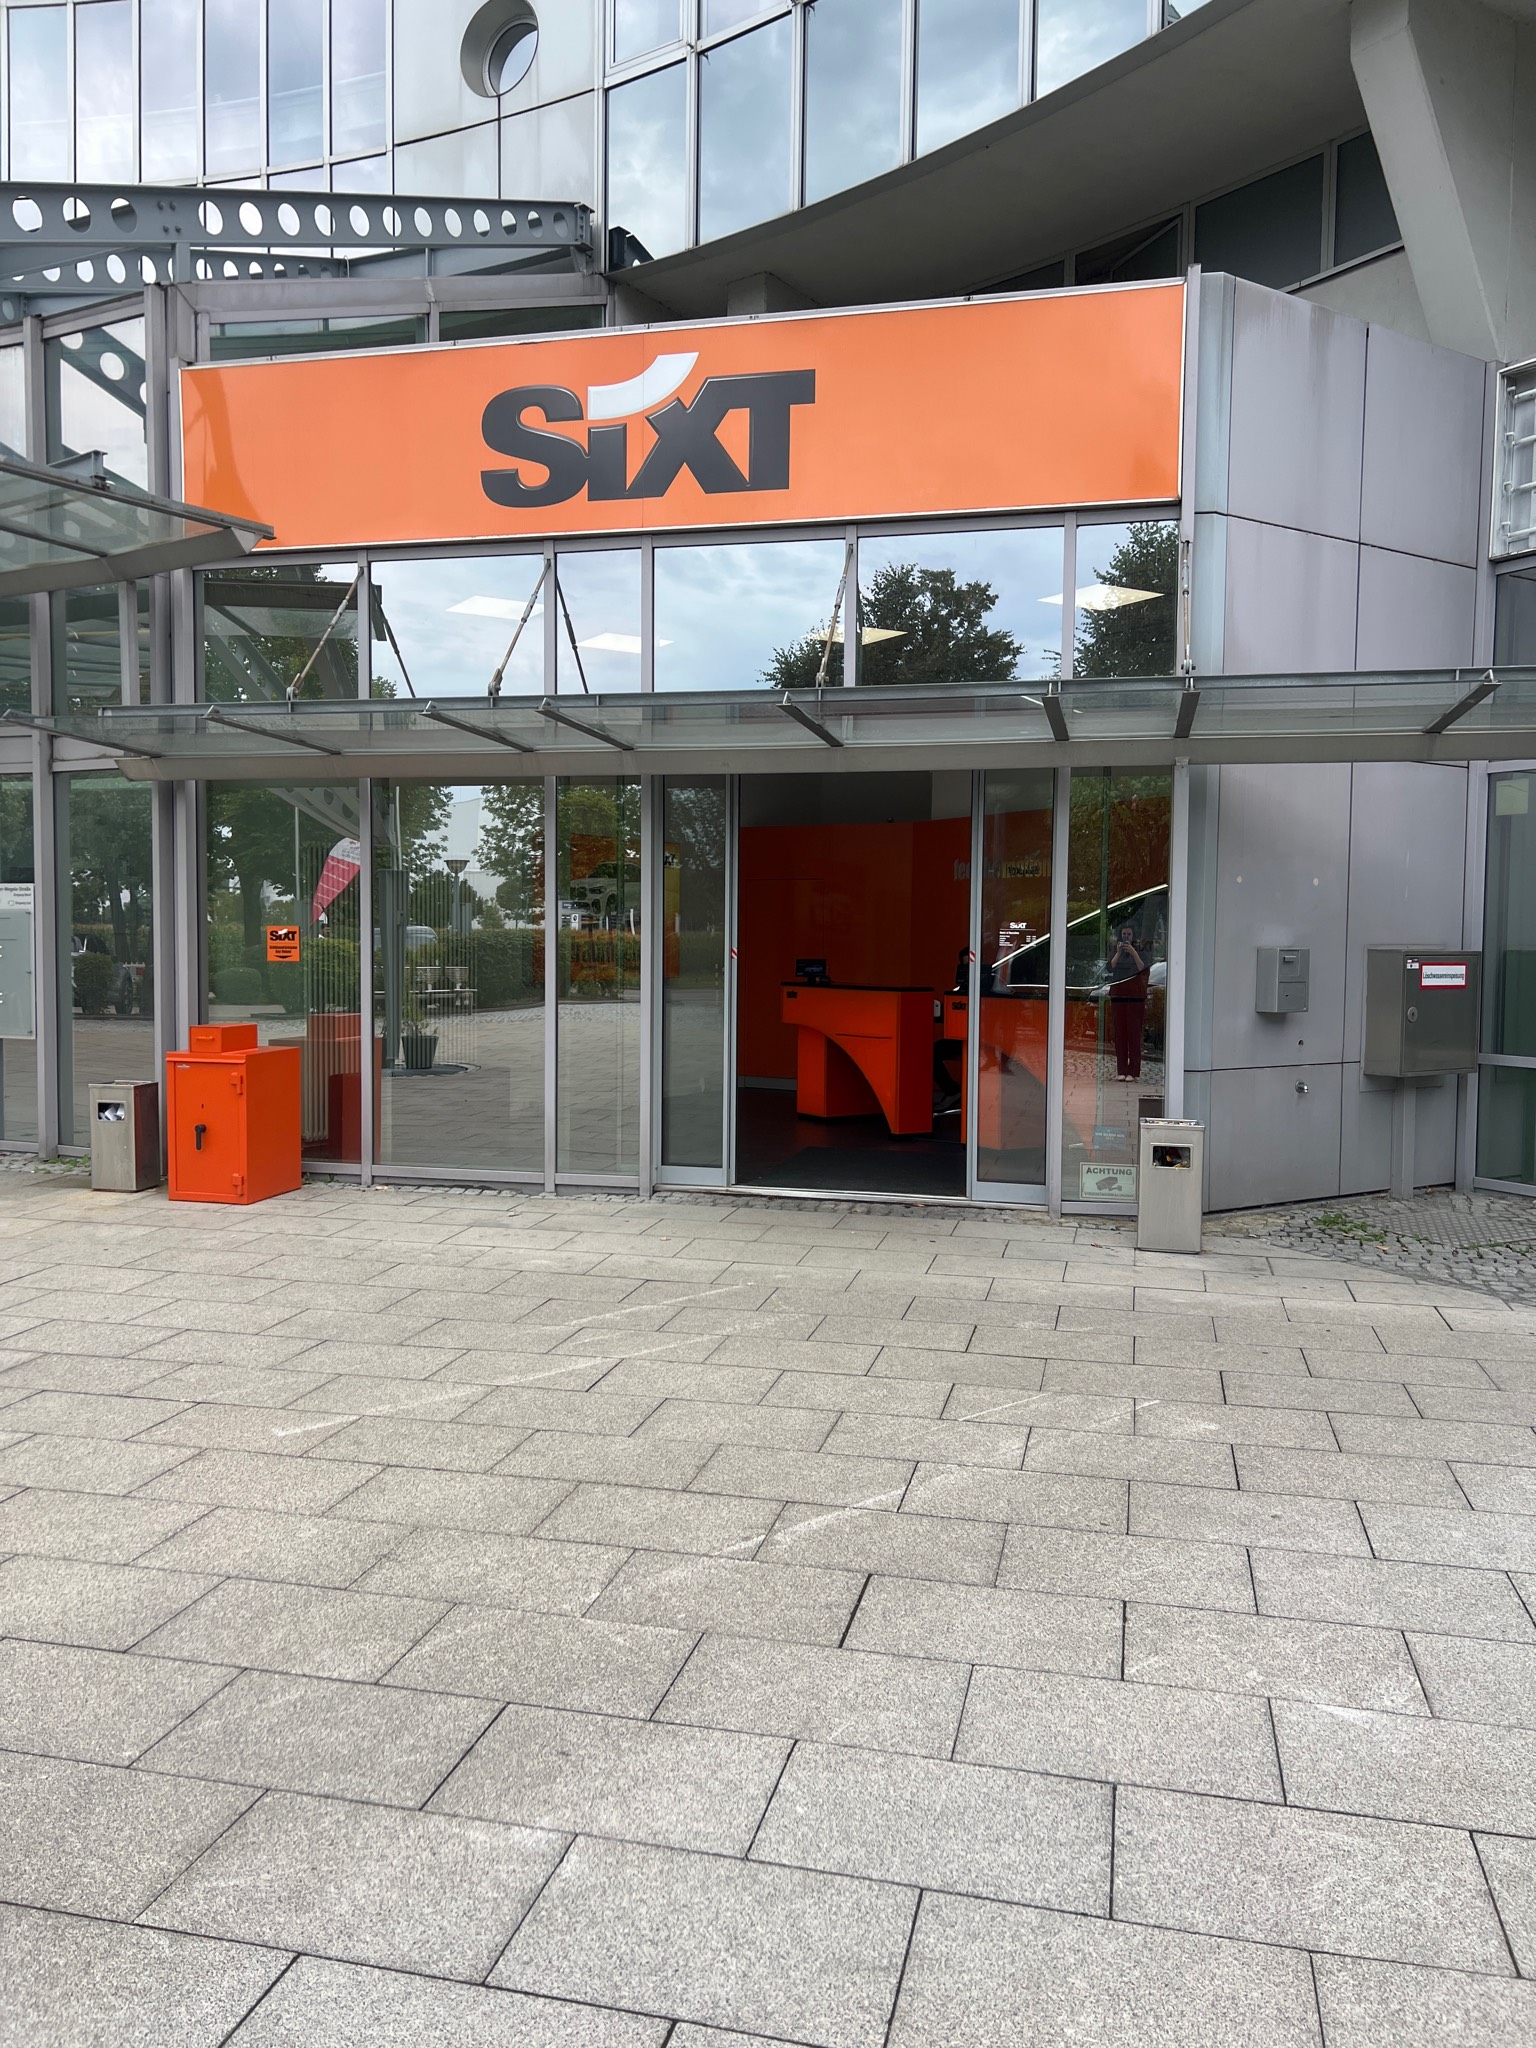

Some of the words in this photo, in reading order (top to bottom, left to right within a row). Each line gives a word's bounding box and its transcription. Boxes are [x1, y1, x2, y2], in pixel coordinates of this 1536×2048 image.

[481, 352, 815, 508] SIXT
[1009, 921, 1027, 929] SIXT
[269, 929, 297, 941] SIXT
[1086, 1167, 1133, 1176] ACHTUNG
